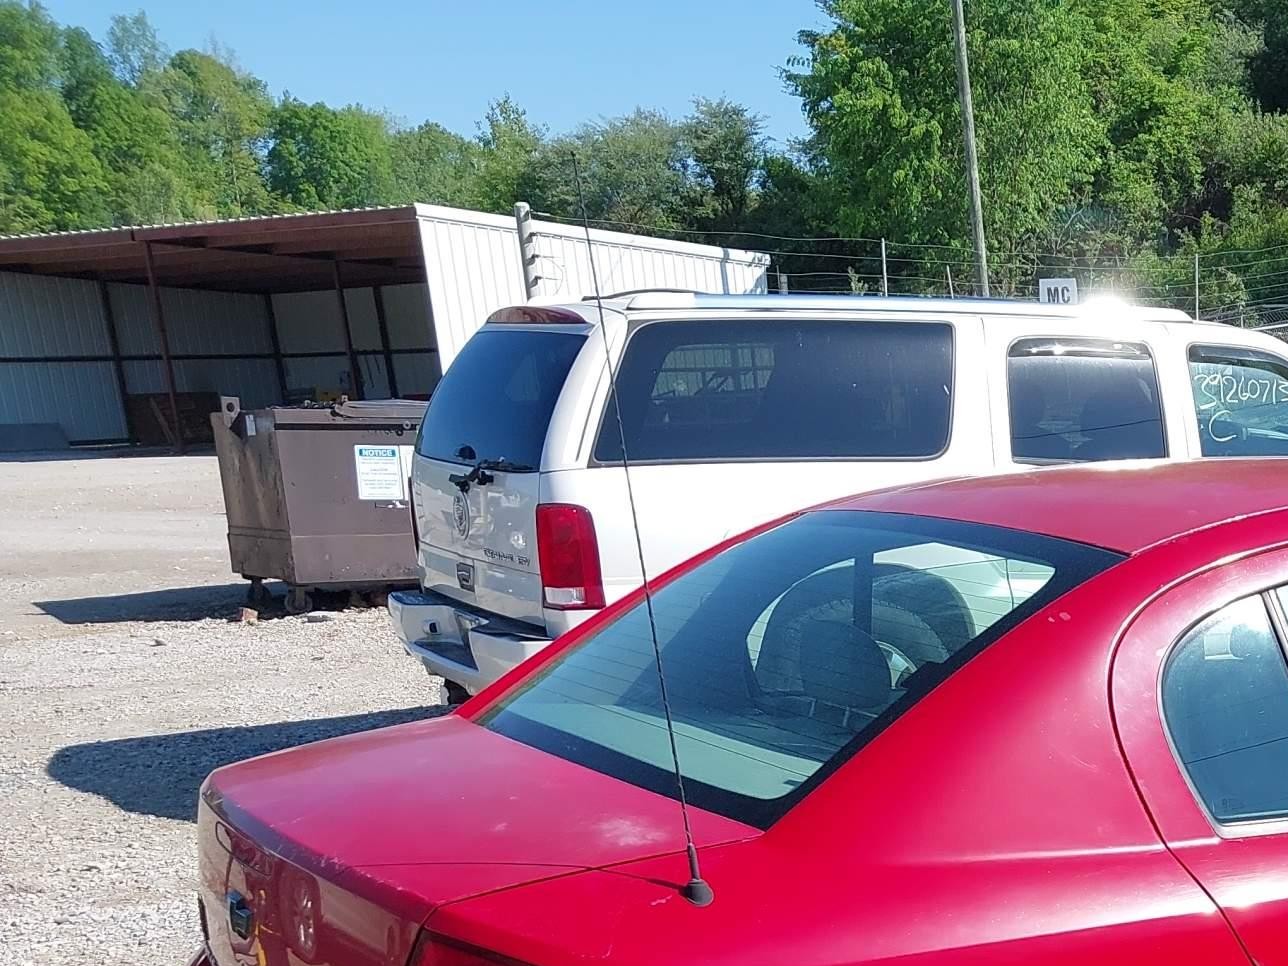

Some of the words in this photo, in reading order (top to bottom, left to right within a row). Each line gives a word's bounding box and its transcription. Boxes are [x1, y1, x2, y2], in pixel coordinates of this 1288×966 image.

[1047, 287, 1071, 304] MC
[1208, 410, 1238, 442] C
[361, 449, 393, 457] NOTICE
